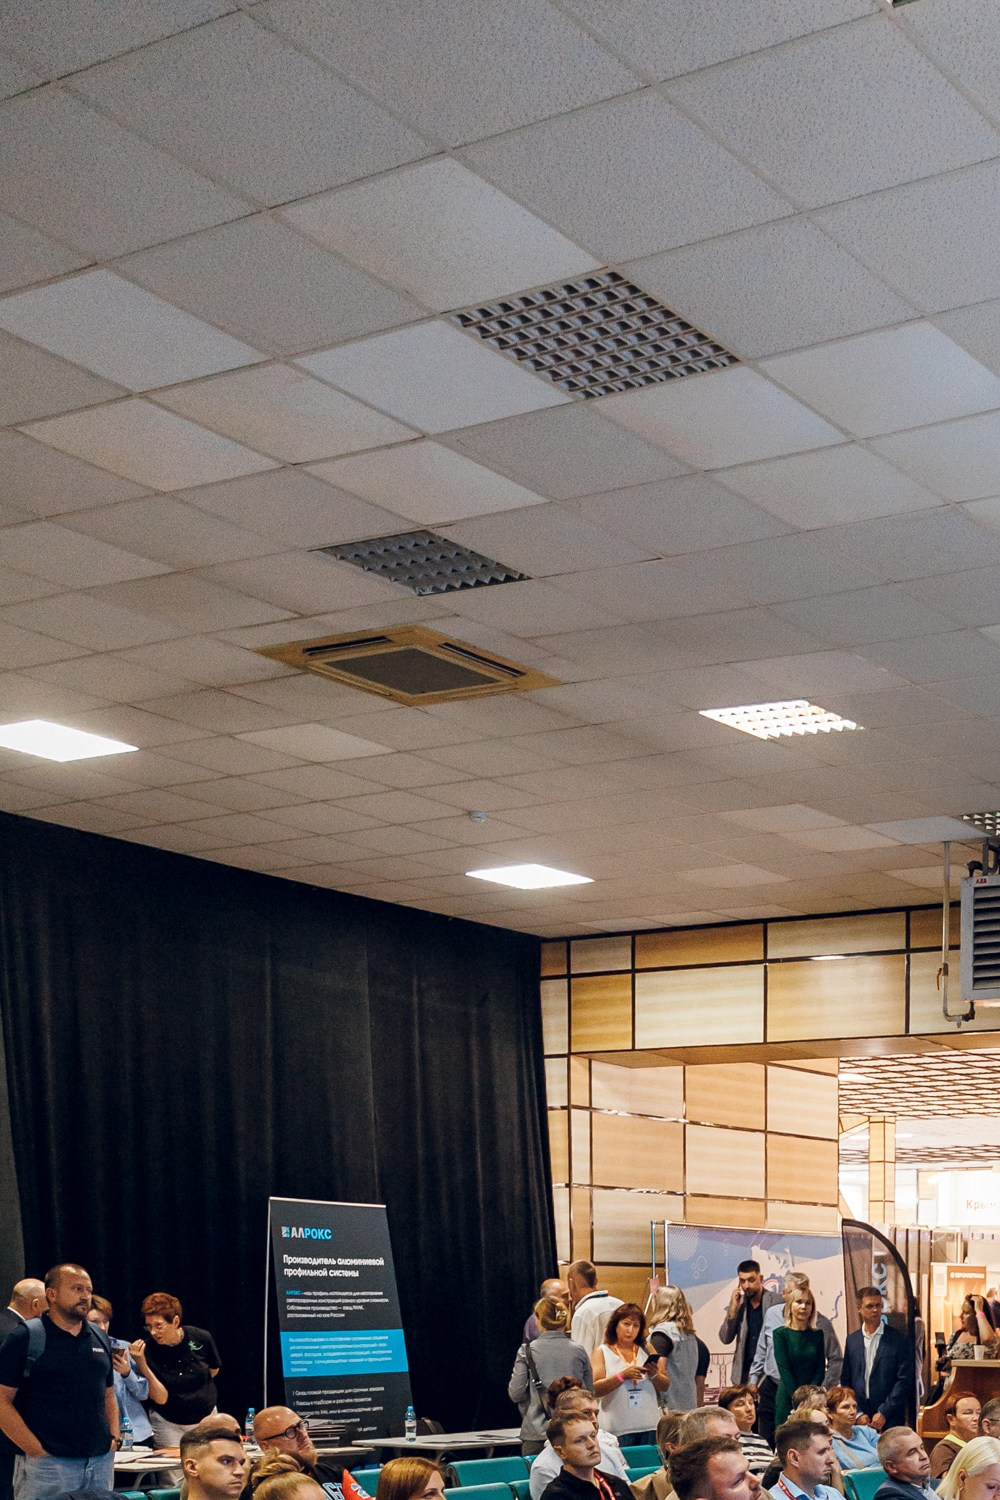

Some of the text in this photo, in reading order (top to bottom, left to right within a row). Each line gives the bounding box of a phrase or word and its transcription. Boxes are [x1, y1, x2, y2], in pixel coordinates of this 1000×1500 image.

[291, 1226, 332, 1240] АЛРОКС
[283, 1254, 384, 1266] Производитель алюминиевой
[284, 1268, 359, 1278] профильной системы
